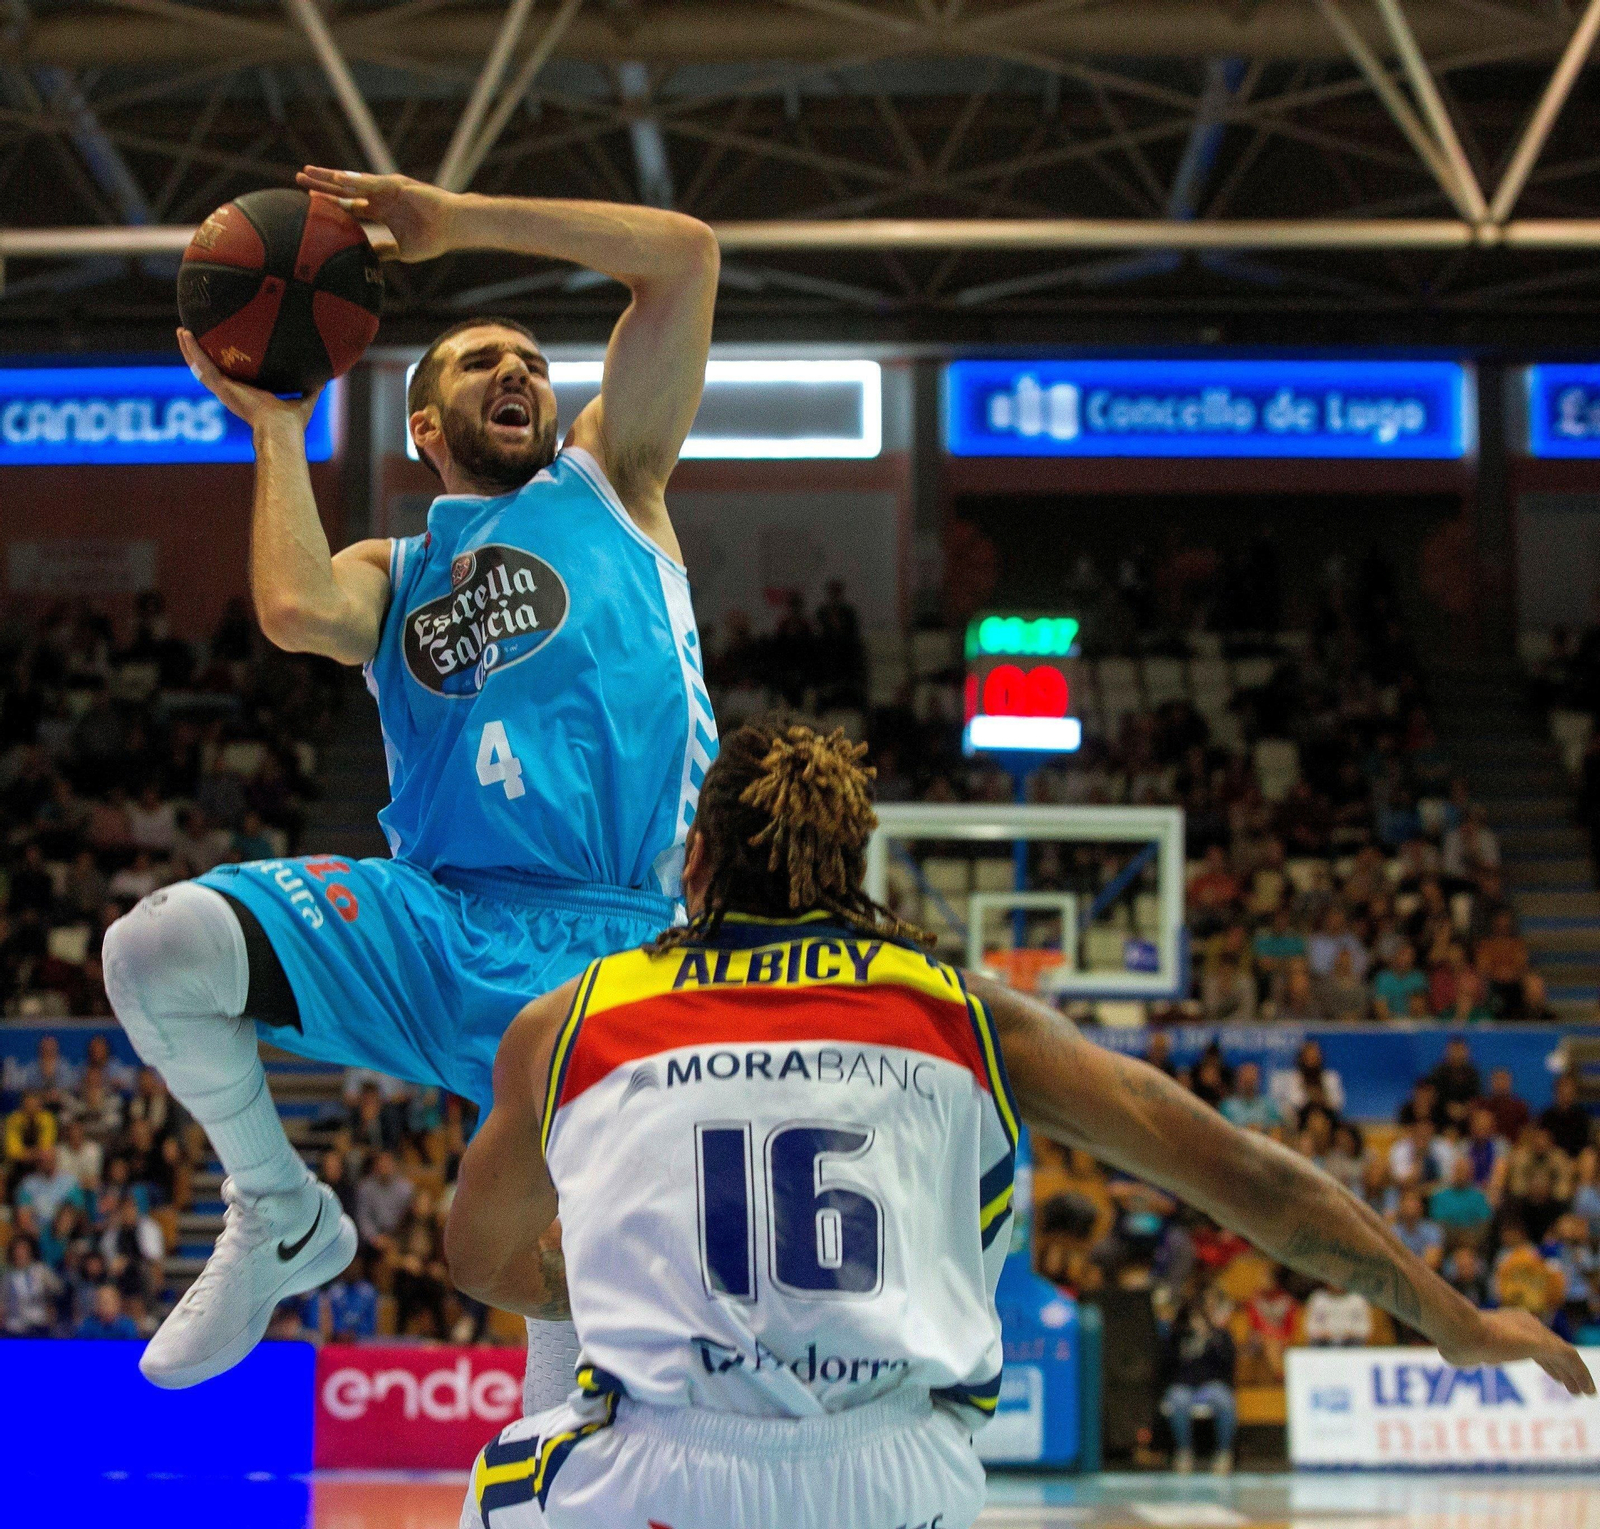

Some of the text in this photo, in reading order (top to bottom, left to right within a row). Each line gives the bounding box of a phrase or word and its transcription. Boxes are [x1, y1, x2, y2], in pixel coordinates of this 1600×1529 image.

[2, 402, 225, 443] CANDELAS
[1087, 389, 1425, 443] Concello de Lugo
[414, 563, 538, 651] Estrella
[429, 599, 540, 675] Galicia
[476, 720, 526, 801] 4
[254, 860, 324, 930] tura
[672, 938, 887, 991] ALBICY
[667, 1046, 938, 1100] MORABANC
[695, 1118, 884, 1304] 16
[322, 1355, 522, 1422] ende
[1371, 1364, 1527, 1406] LEYMA
[1375, 1416, 1589, 1457] natura
